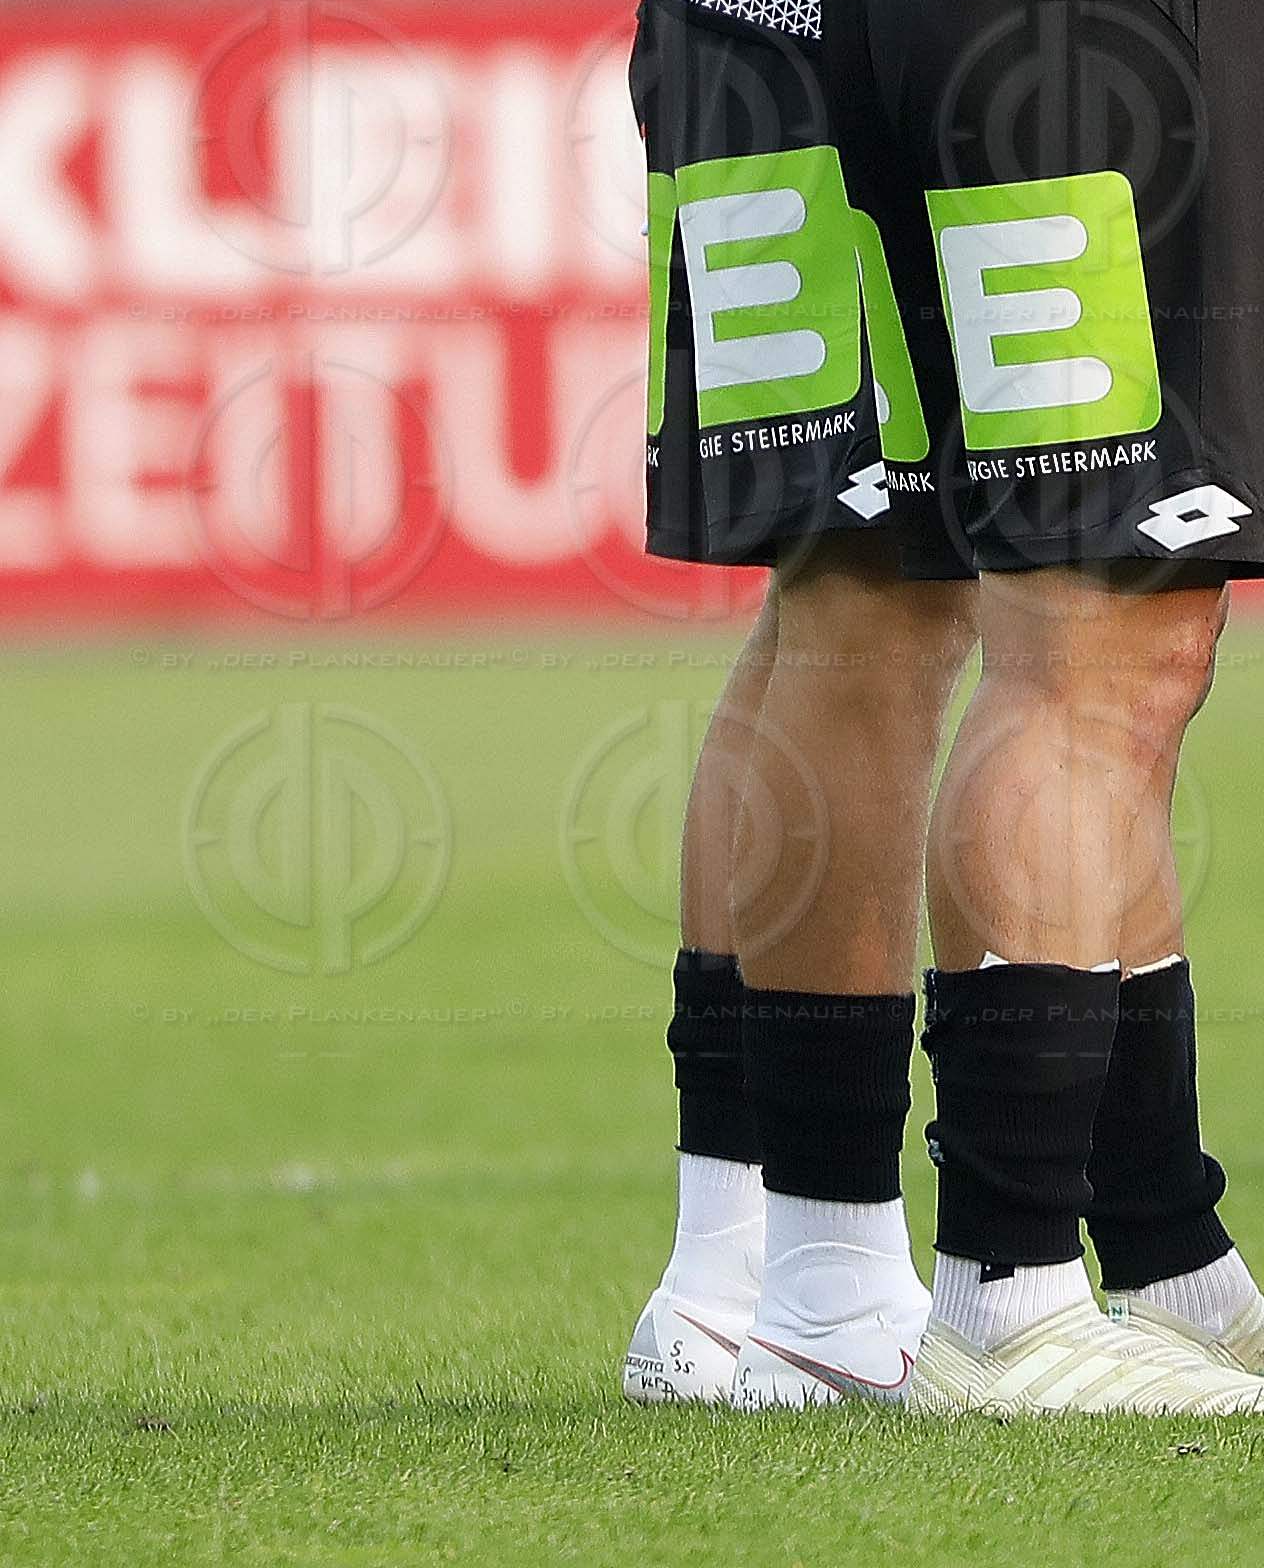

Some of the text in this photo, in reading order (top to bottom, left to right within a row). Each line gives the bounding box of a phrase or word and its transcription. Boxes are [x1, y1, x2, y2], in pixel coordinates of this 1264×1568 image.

[940, 213, 1114, 413] E
[731, 412, 856, 453] STEIERMARK
[1016, 439, 1157, 478] STEIERMARK
